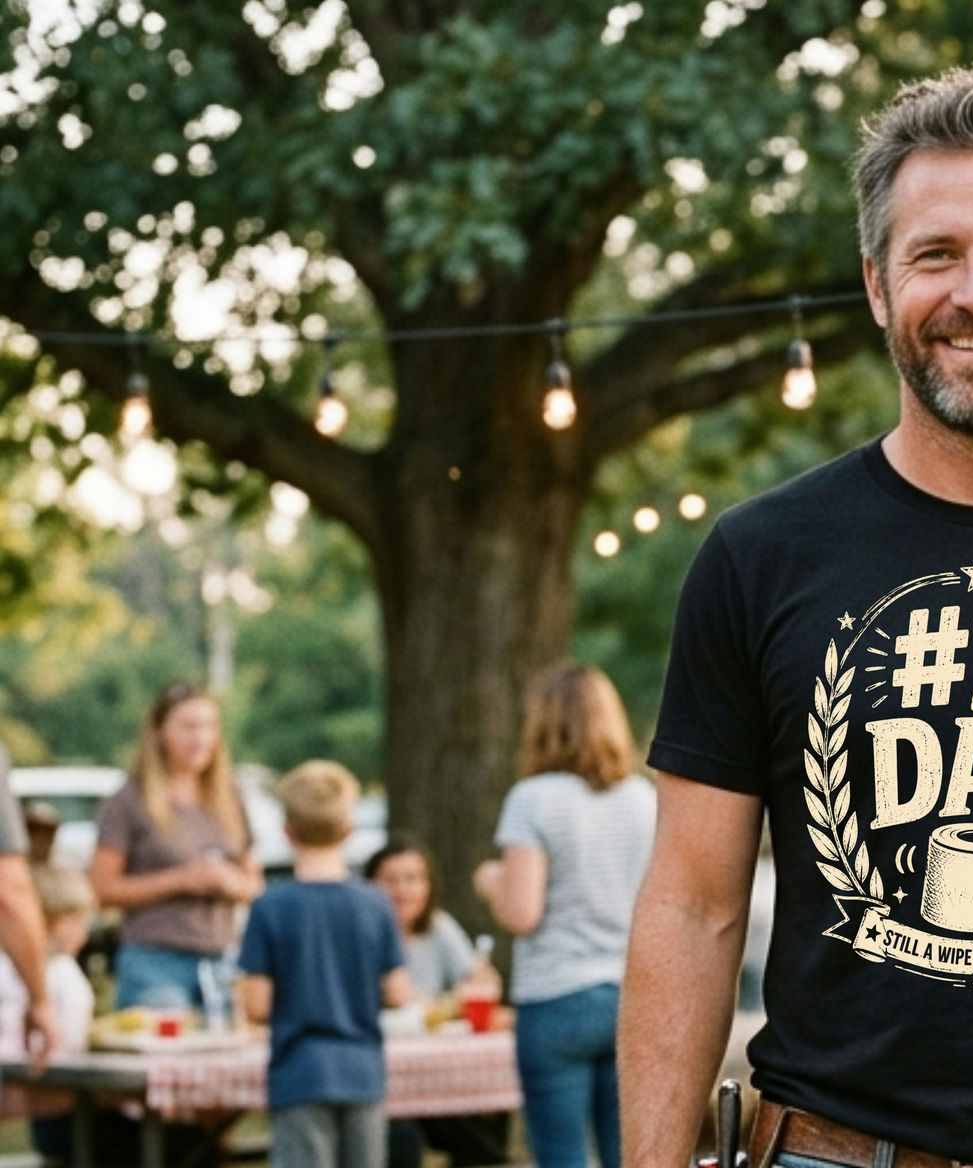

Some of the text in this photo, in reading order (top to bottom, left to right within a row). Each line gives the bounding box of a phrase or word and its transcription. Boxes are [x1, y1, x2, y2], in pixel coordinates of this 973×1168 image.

[883, 929, 919, 956] STILL
[923, 943, 933, 960] A
[938, 945, 972, 966] WIPE
